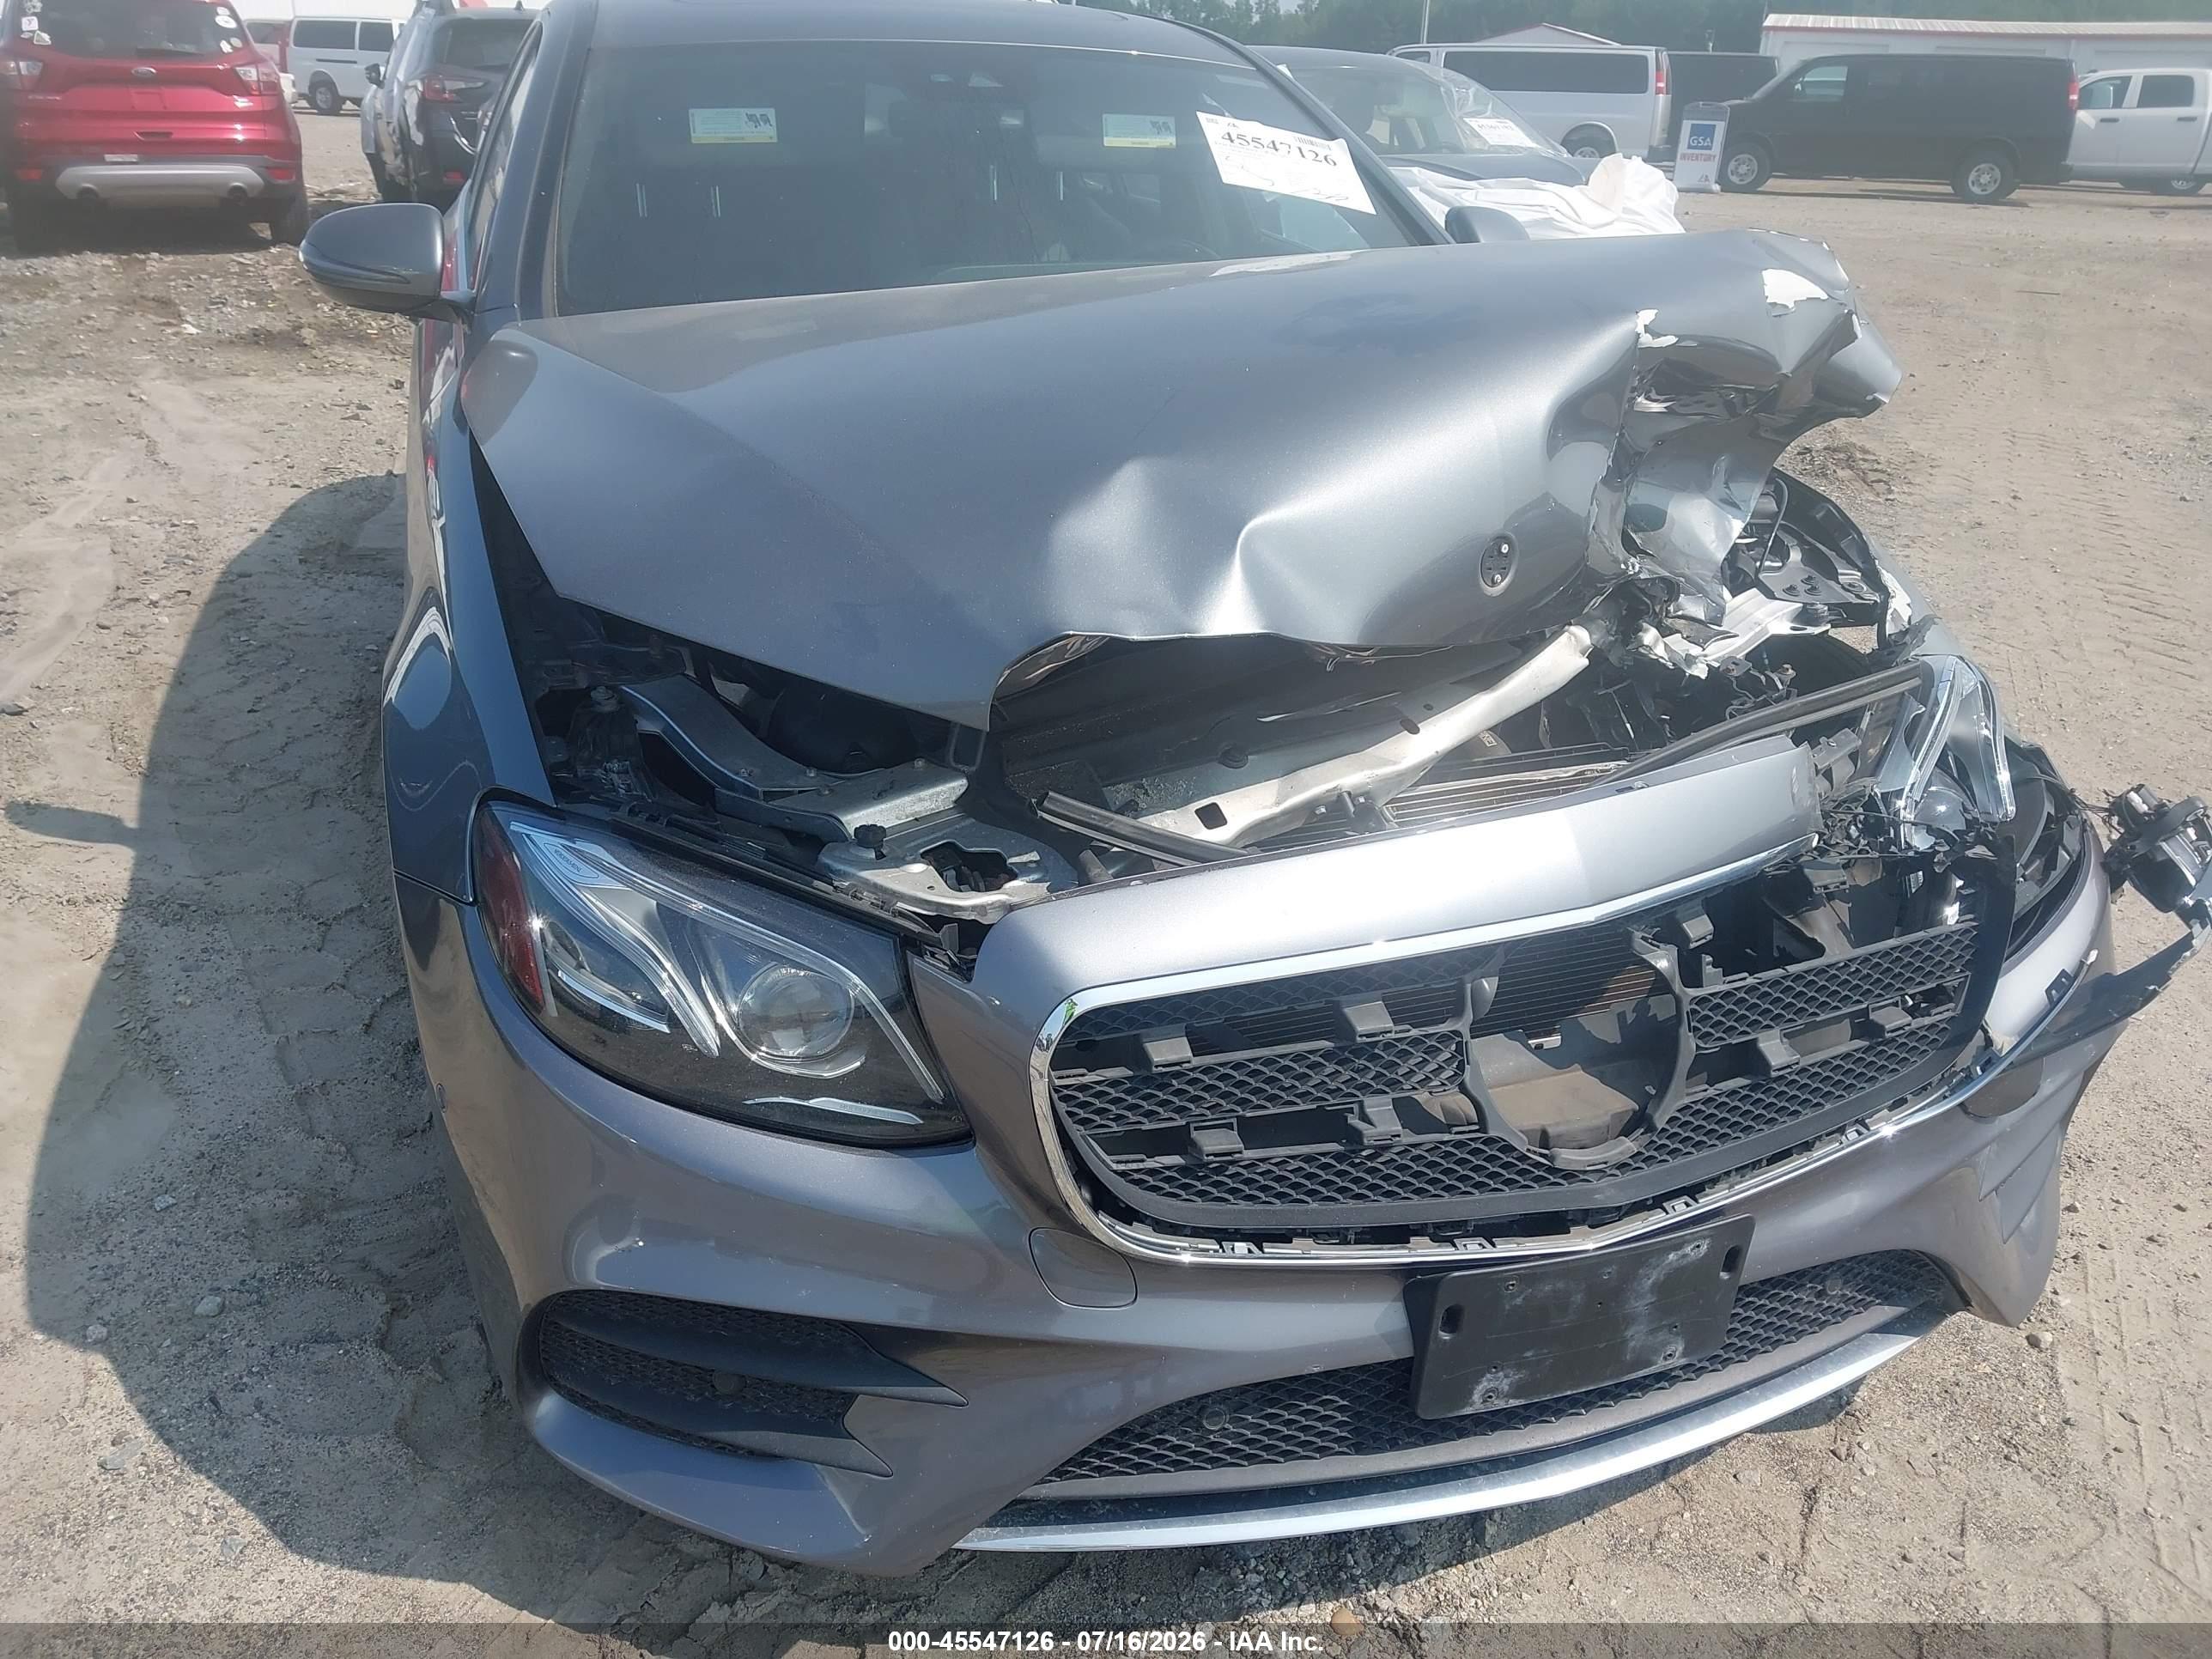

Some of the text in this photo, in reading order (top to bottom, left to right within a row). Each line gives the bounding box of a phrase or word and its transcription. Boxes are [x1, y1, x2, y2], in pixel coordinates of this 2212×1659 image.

[1689, 136, 1712, 147] GSA
[1221, 131, 1338, 167] 45547126
[1679, 152, 1716, 162] INVENTORY
